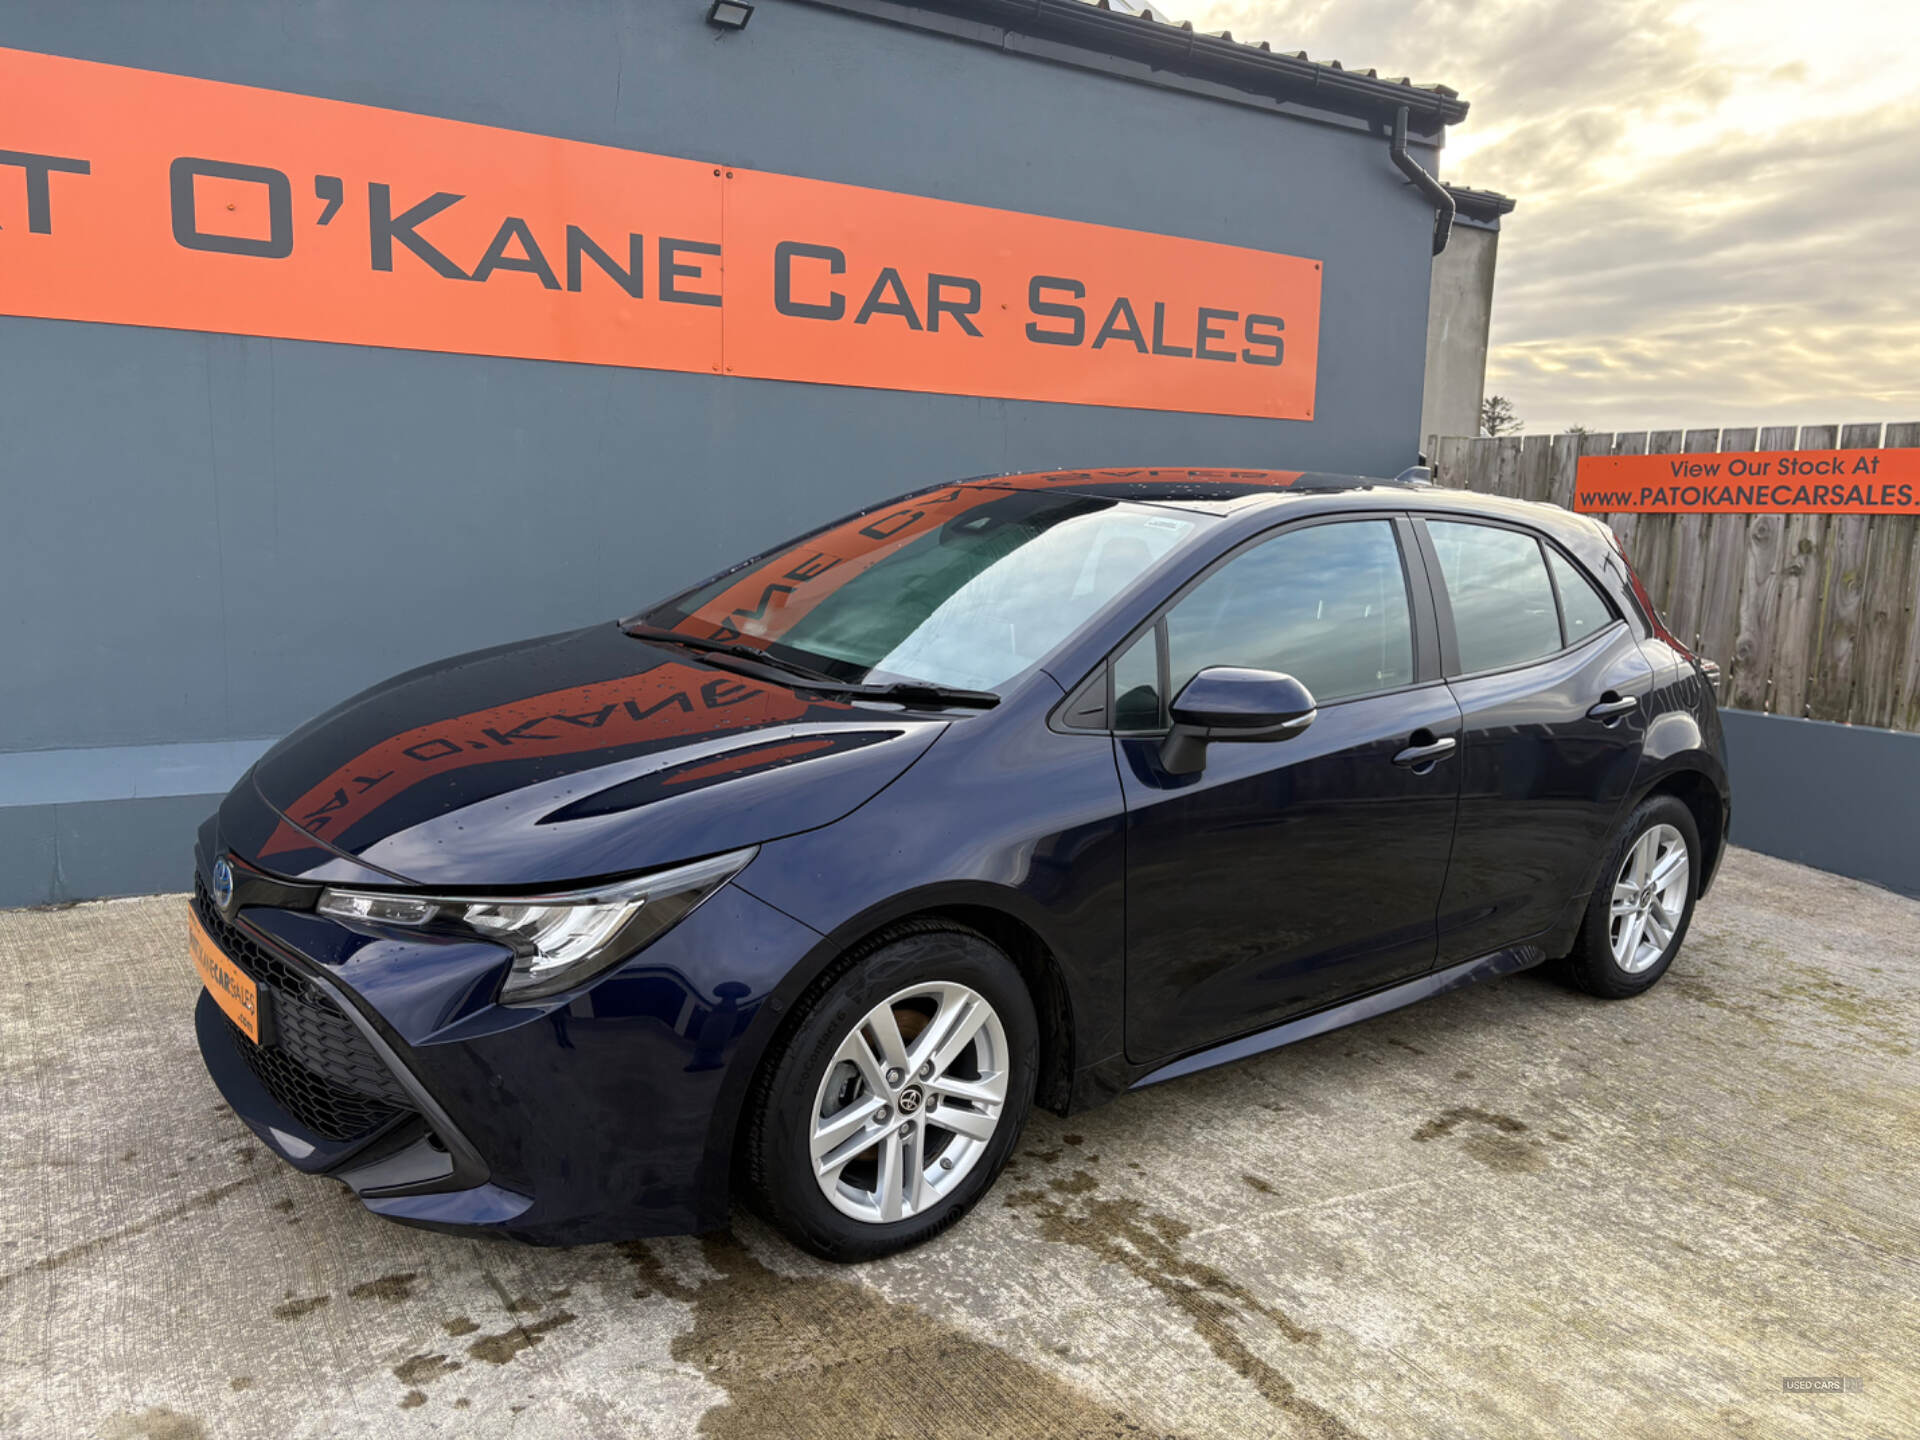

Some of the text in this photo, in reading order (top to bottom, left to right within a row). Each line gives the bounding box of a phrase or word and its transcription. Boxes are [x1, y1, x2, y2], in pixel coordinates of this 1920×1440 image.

[0, 149, 91, 235] T
[169, 156, 723, 307] O'KANE
[1670, 456, 1880, 478] View Our Stock At
